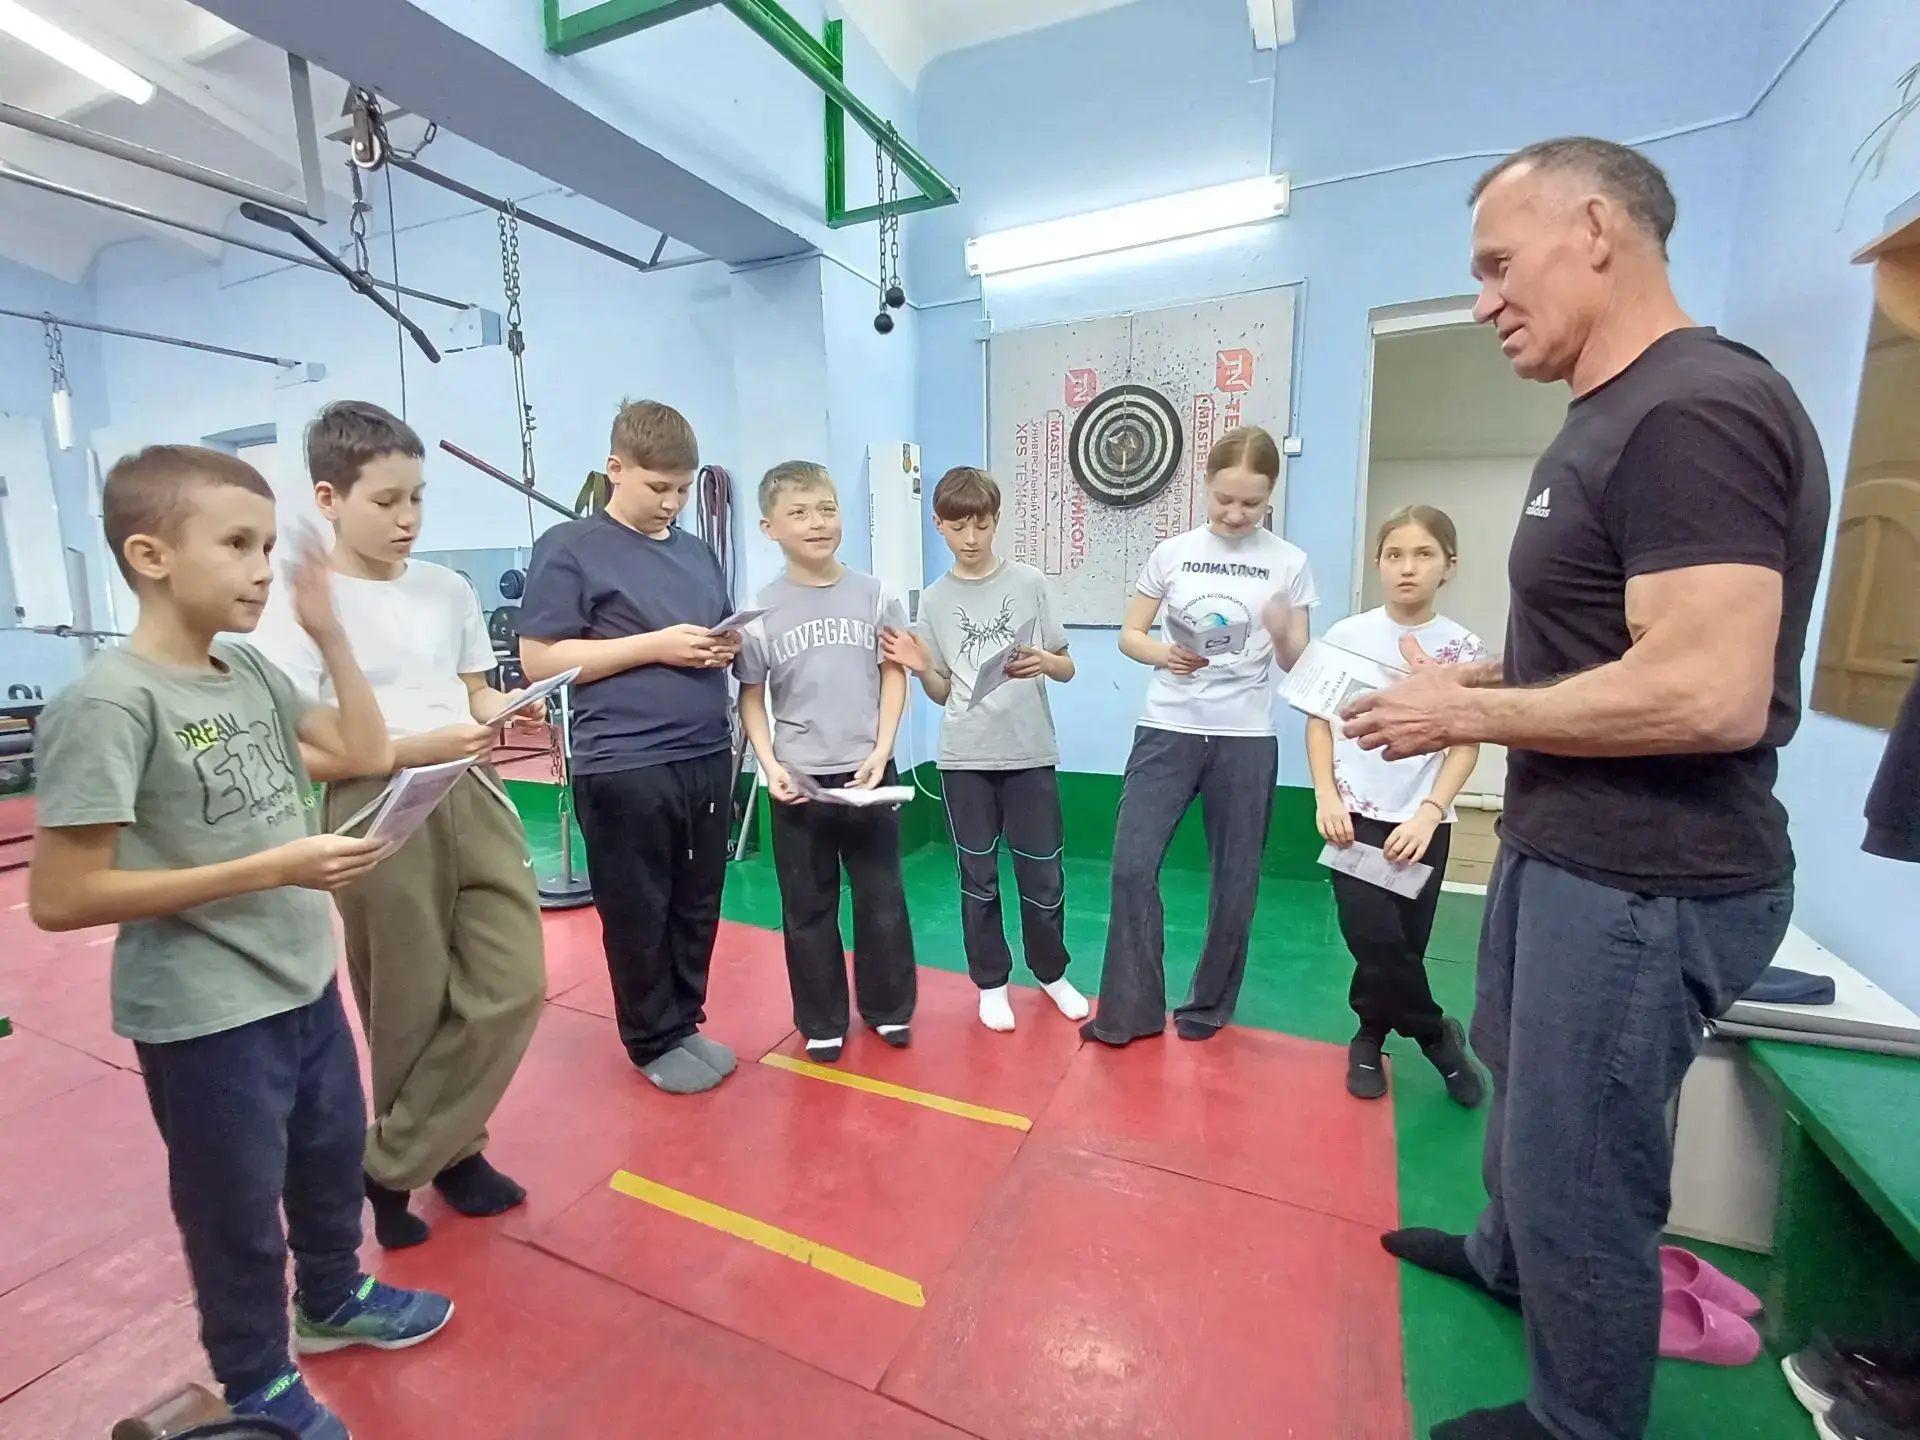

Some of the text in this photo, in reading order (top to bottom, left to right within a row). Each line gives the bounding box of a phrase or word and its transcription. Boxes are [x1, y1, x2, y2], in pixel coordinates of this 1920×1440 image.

[1050, 420, 1060, 480] MASTER
[1014, 423, 1028, 564] XPS ТЕХНОПЛЕК
[772, 617, 875, 665] LOVEGANG
[174, 712, 241, 751] DREAM
